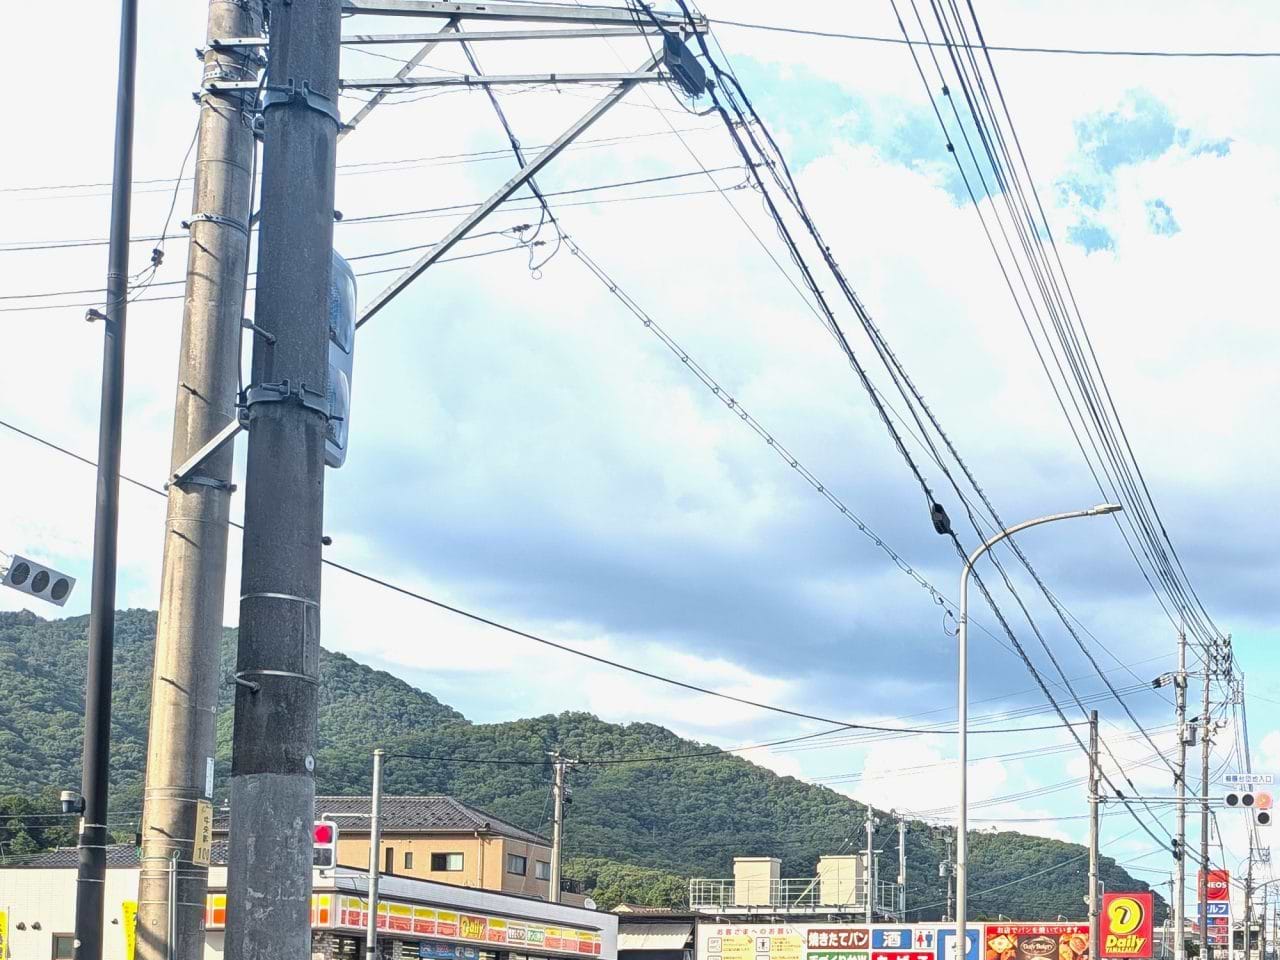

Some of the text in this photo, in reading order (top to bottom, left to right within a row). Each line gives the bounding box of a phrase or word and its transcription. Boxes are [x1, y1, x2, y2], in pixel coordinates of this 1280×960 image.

[1202, 904, 1226, 913] ルフ
[808, 931, 868, 947] 焼きたてパン
[883, 931, 901, 947] 酒
[1106, 935, 1146, 952] Daily
